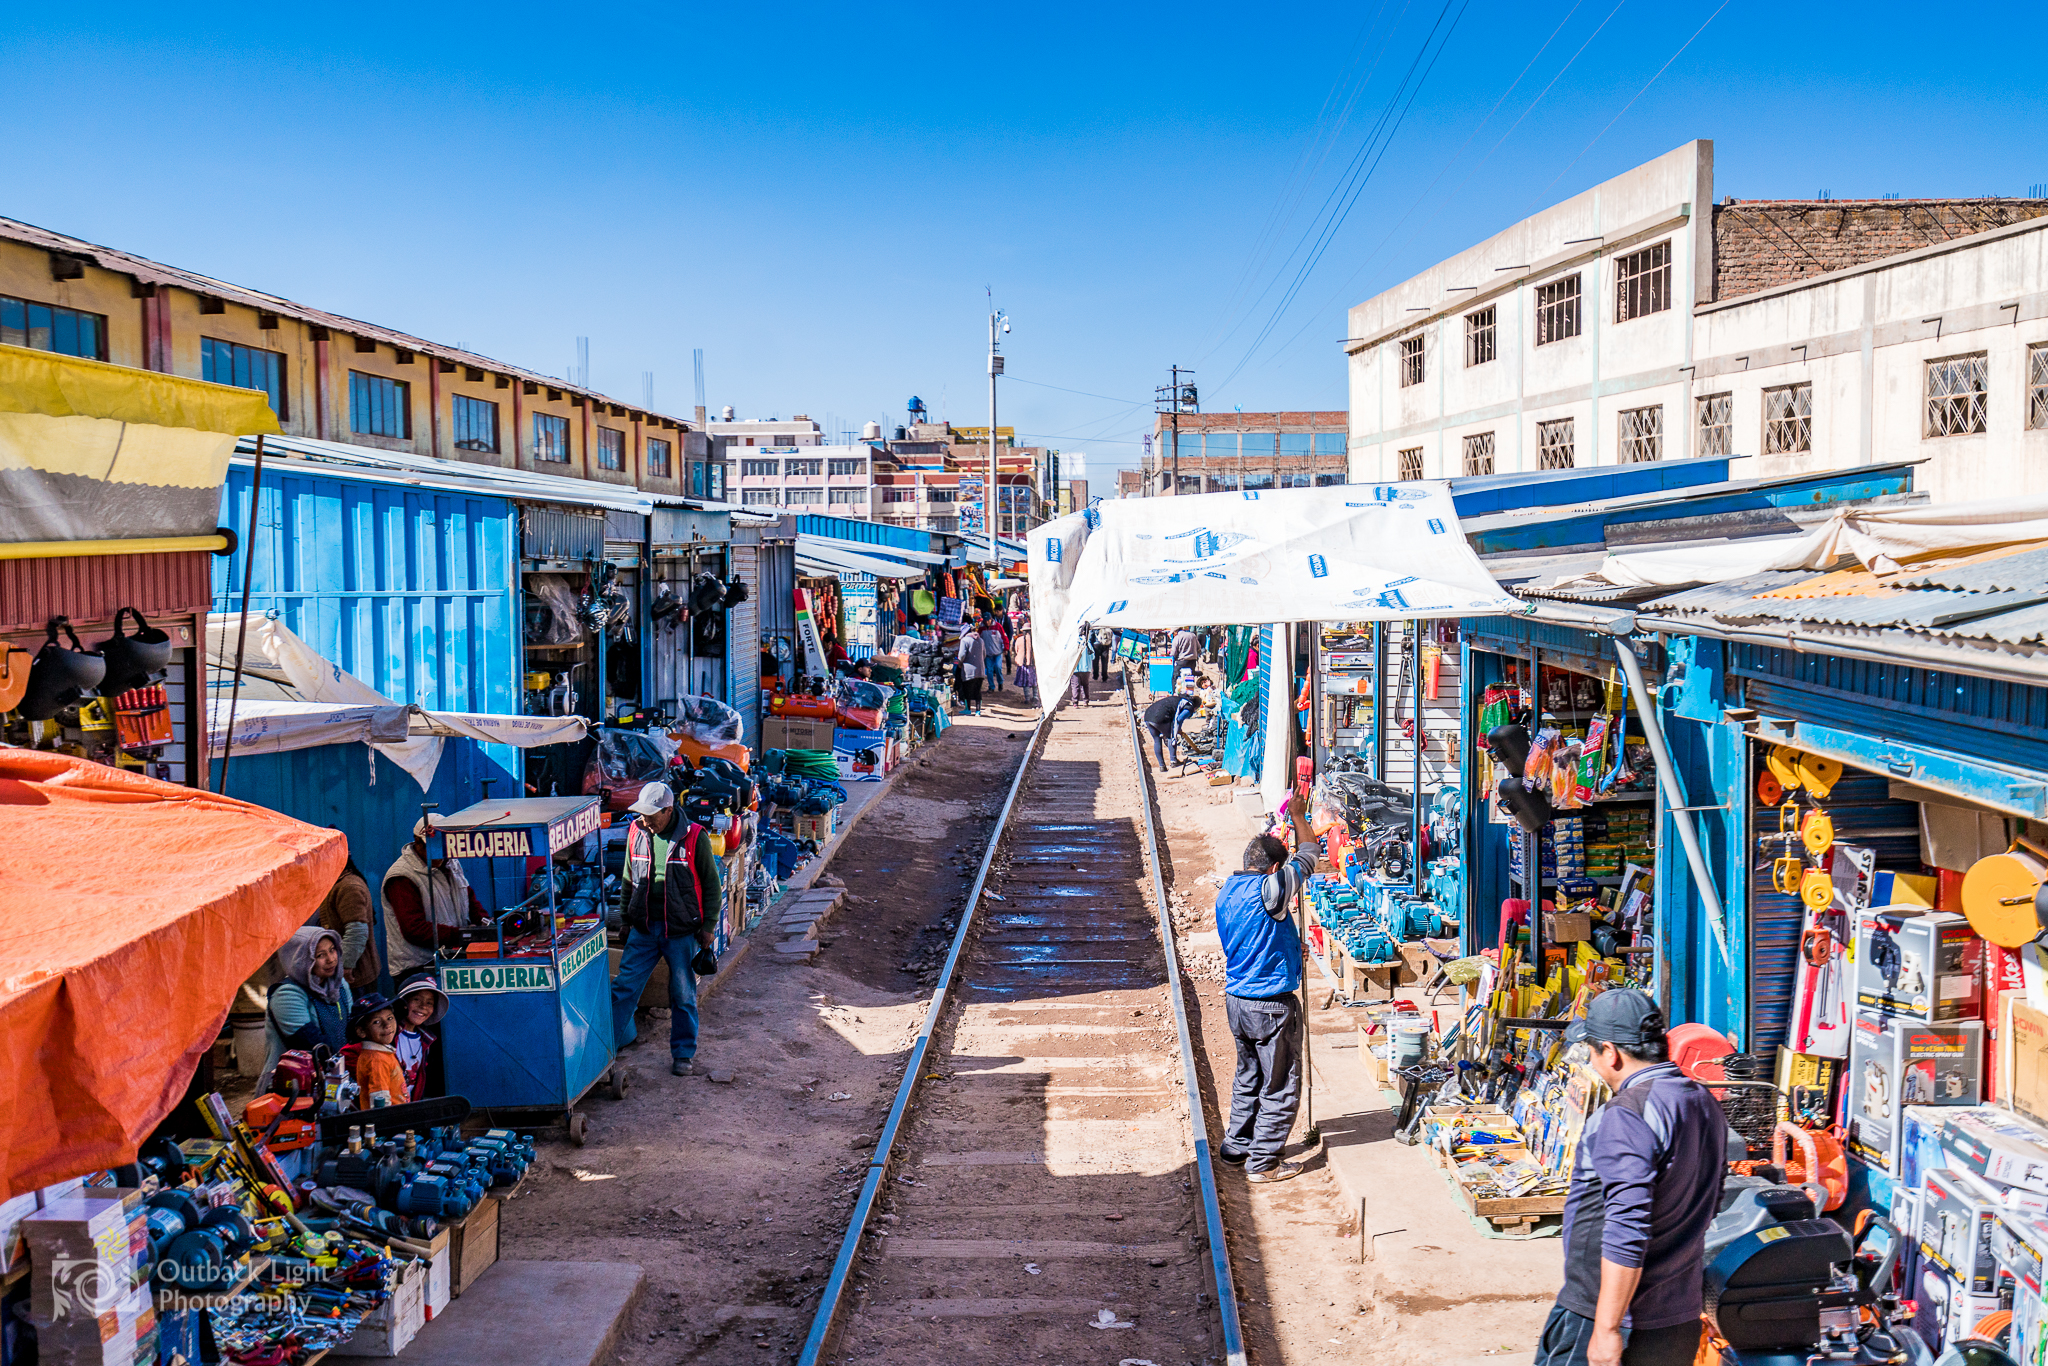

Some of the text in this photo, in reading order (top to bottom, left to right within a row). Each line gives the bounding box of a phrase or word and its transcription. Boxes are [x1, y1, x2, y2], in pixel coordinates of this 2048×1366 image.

[802, 623, 816, 654] FORTE
[789, 727, 814, 735] MITOSHI
[549, 804, 602, 855] RELOJERIA
[446, 831, 531, 858] RELOJERIA
[561, 932, 605, 980] RELOJERIA
[446, 967, 550, 989] RELOJERIA
[1910, 1034, 1968, 1045] CROWN
[2020, 1201, 2043, 1209] CROWN
